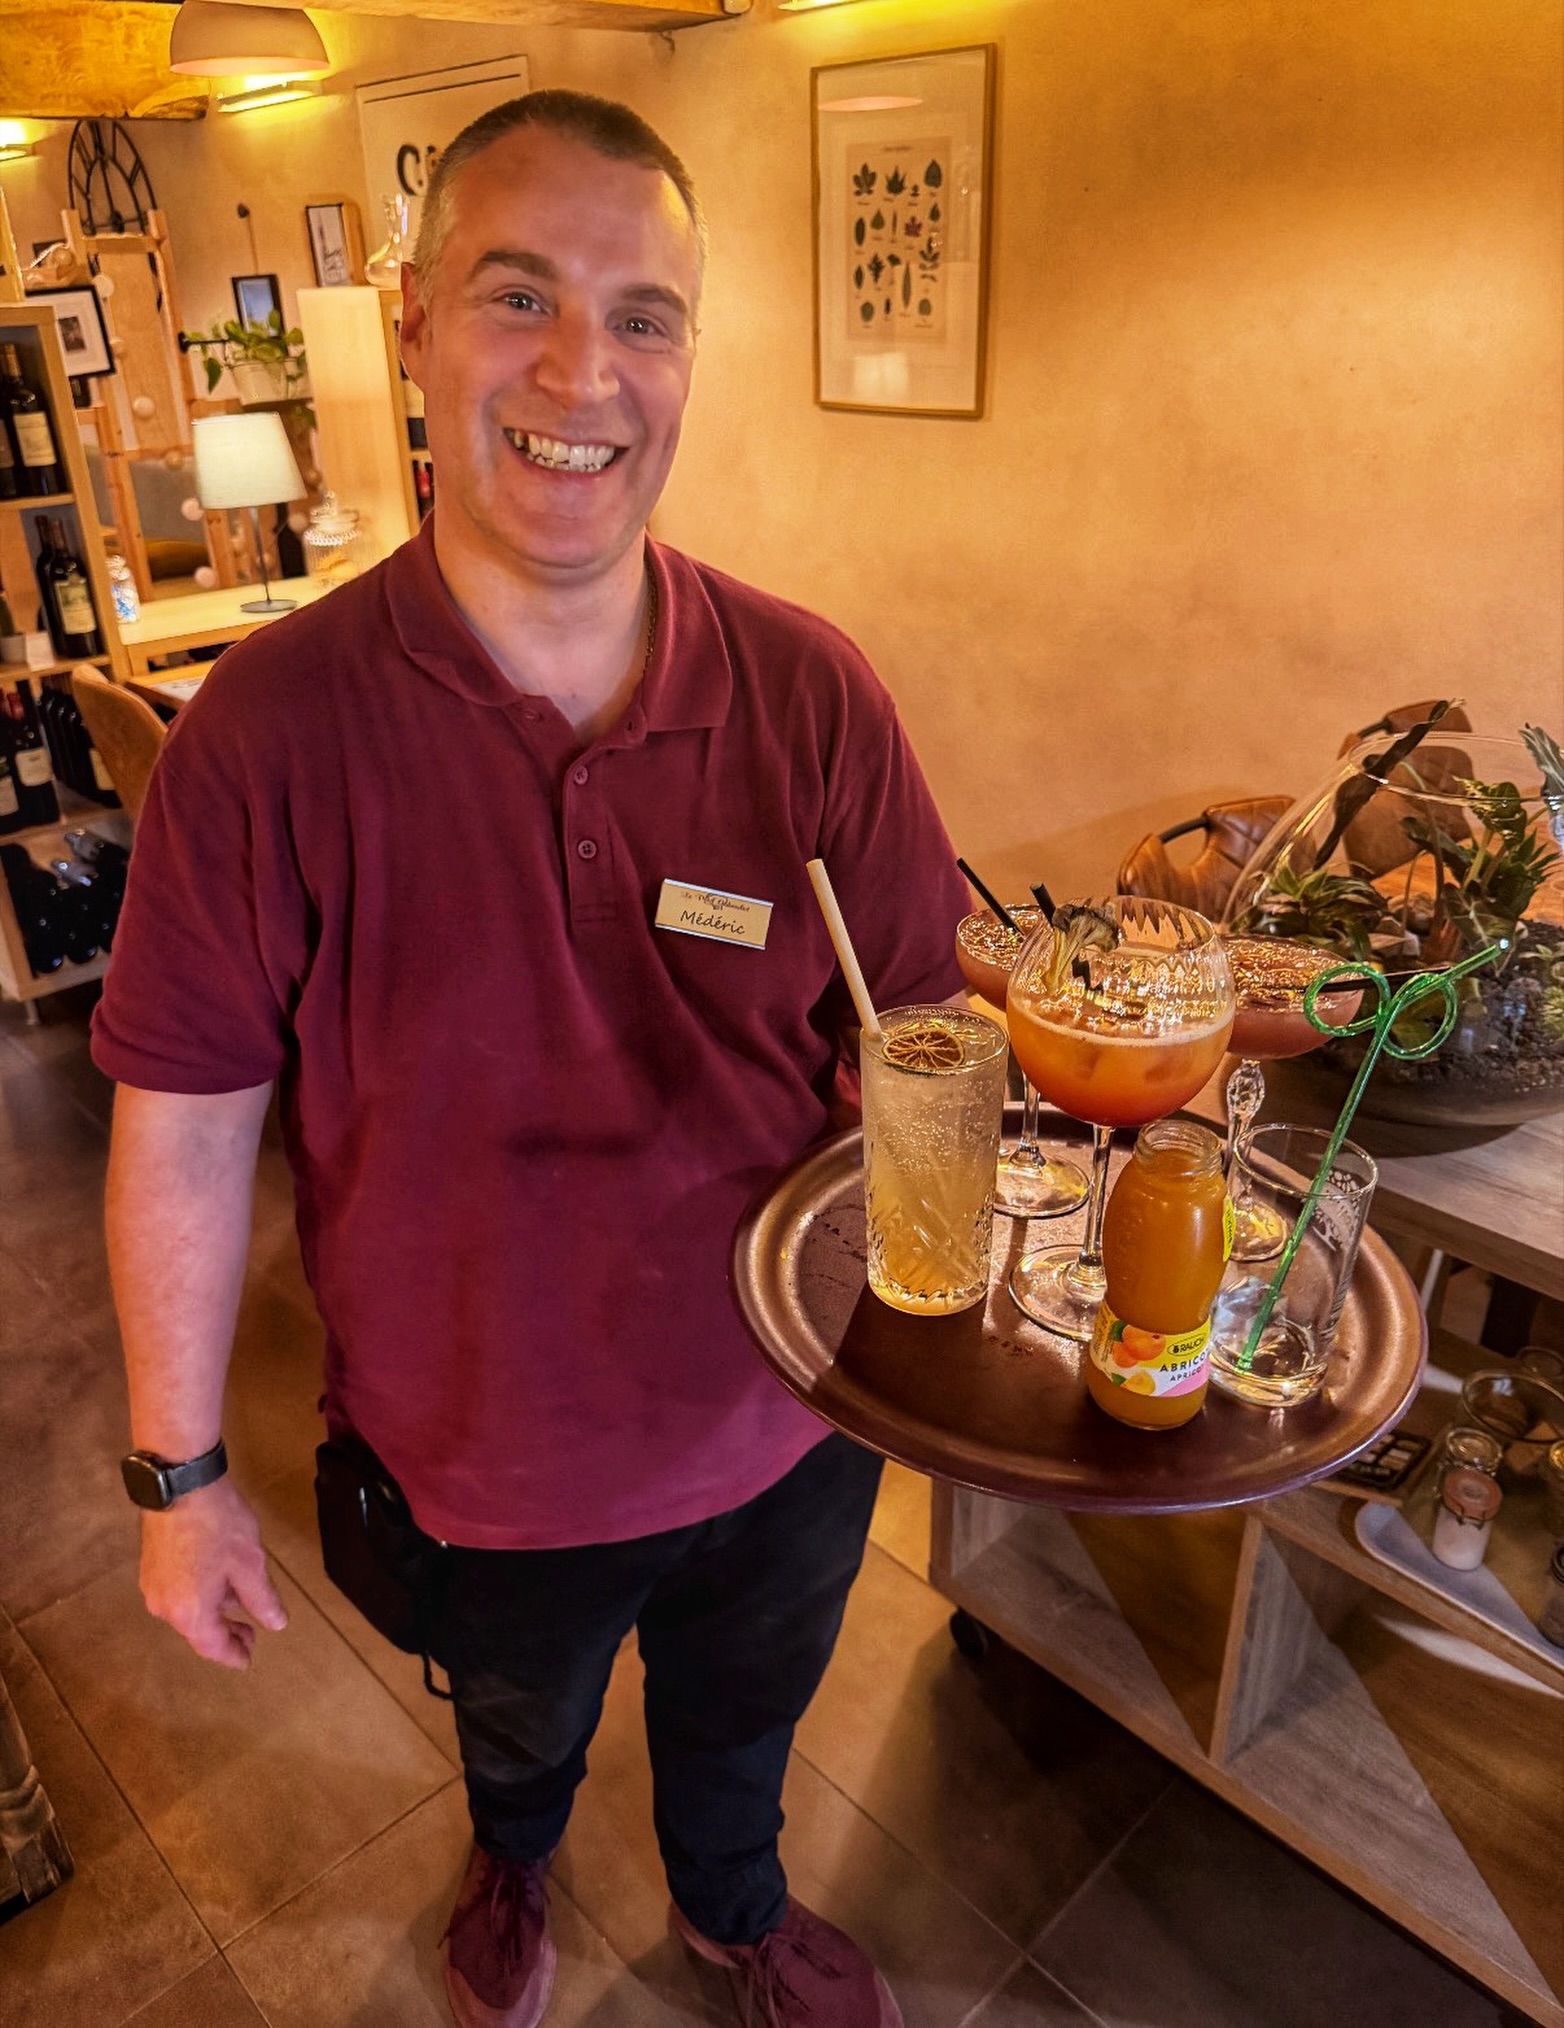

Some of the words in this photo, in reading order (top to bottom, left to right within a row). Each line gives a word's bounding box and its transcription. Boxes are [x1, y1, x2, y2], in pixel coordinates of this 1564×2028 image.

[679, 909, 746, 935] Médéric
[1179, 1336, 1204, 1353] RAUCH
[1159, 1347, 1209, 1373] ABRICO
